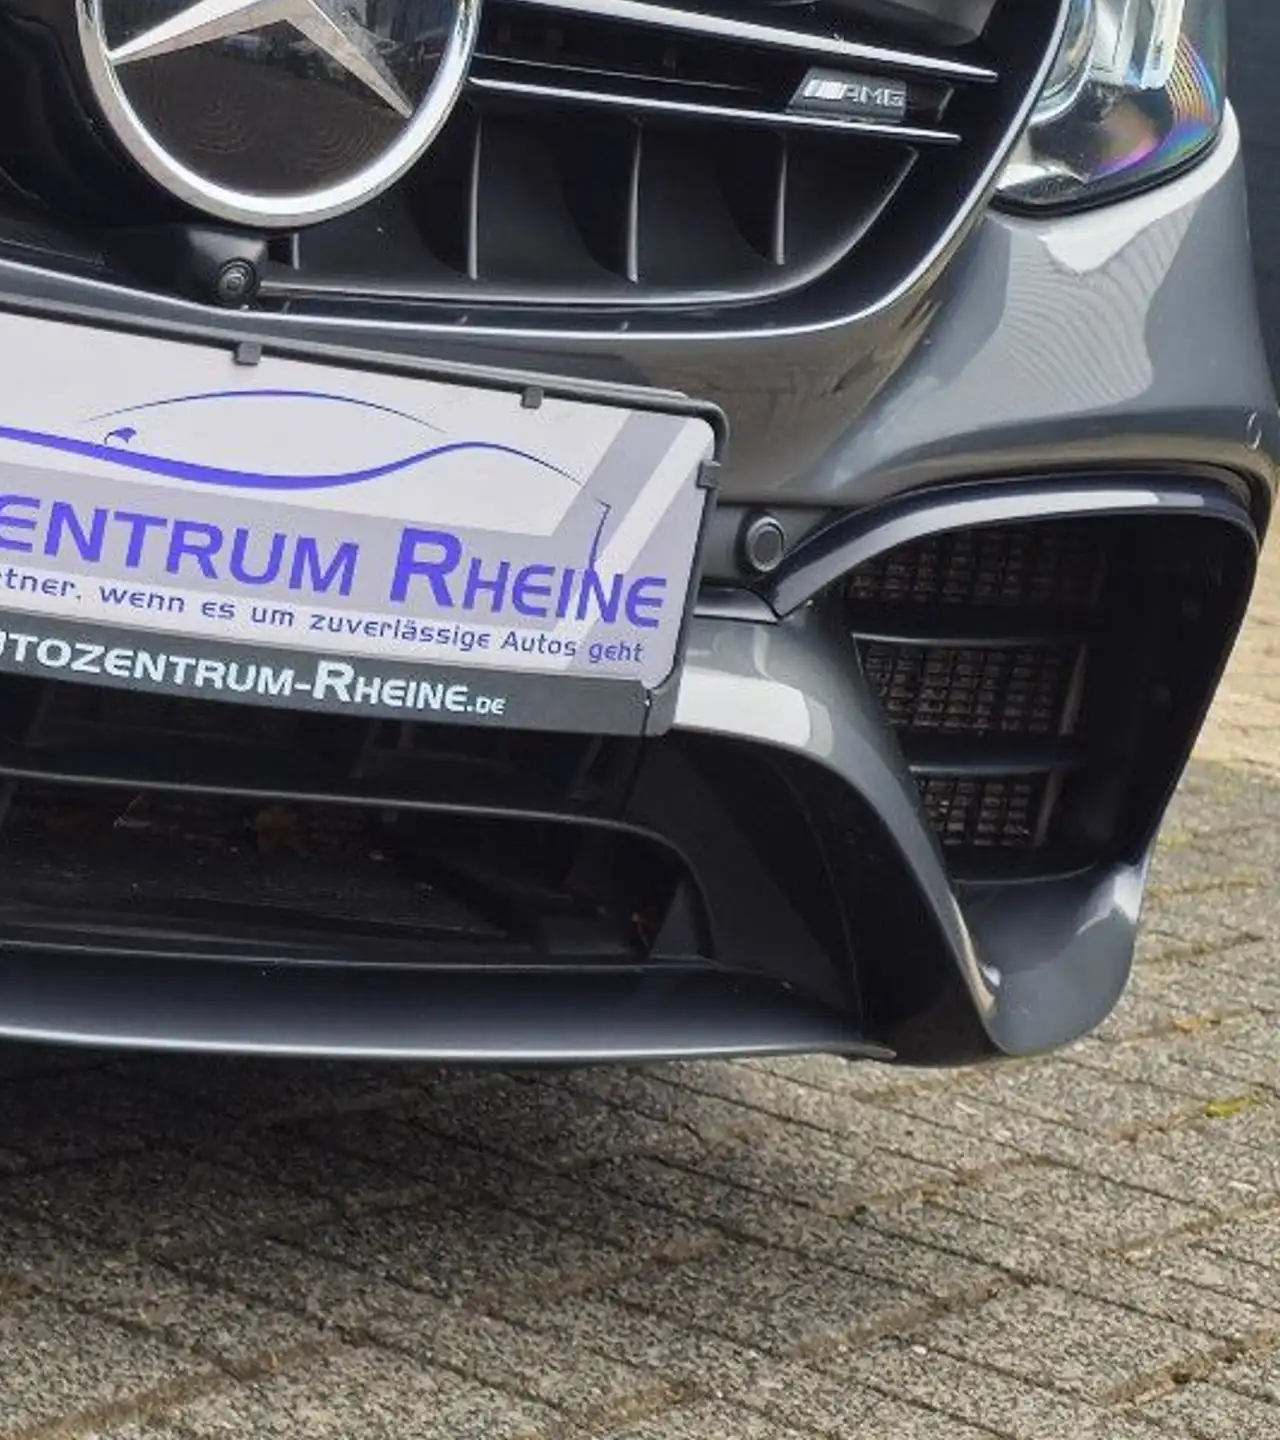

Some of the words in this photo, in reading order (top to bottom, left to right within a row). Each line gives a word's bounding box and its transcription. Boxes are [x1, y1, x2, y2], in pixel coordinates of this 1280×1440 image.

[99, 585, 185, 614] wenn
[201, 601, 236, 621] es
[251, 605, 296, 628] um
[309, 610, 491, 652] zuverlässige
[501, 630, 577, 657] Autos
[588, 641, 644, 663] geht
